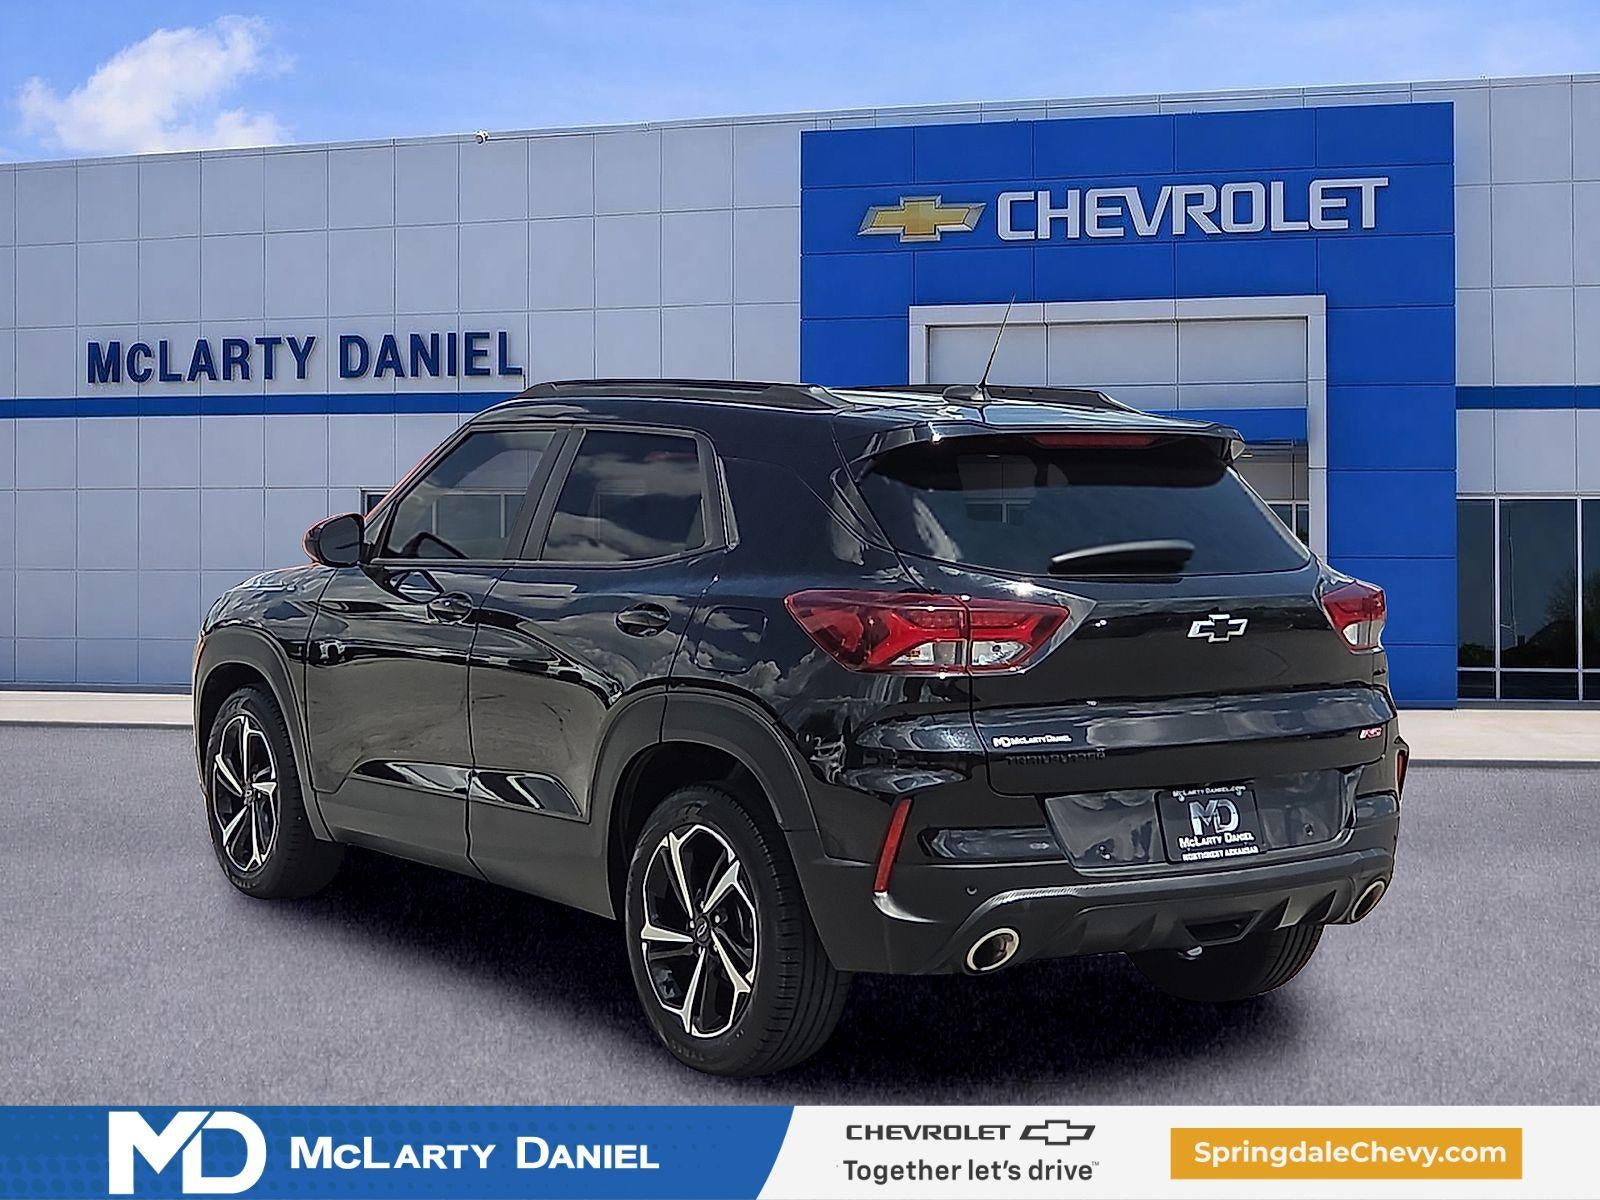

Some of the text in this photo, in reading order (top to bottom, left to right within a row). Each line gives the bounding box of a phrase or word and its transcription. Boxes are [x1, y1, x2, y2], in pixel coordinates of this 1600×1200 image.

[997, 177, 1389, 241] CHEVROLET
[339, 331, 523, 379] DANIEL
[1189, 799, 1239, 835] MD
[1224, 832, 1255, 844] DANIEL
